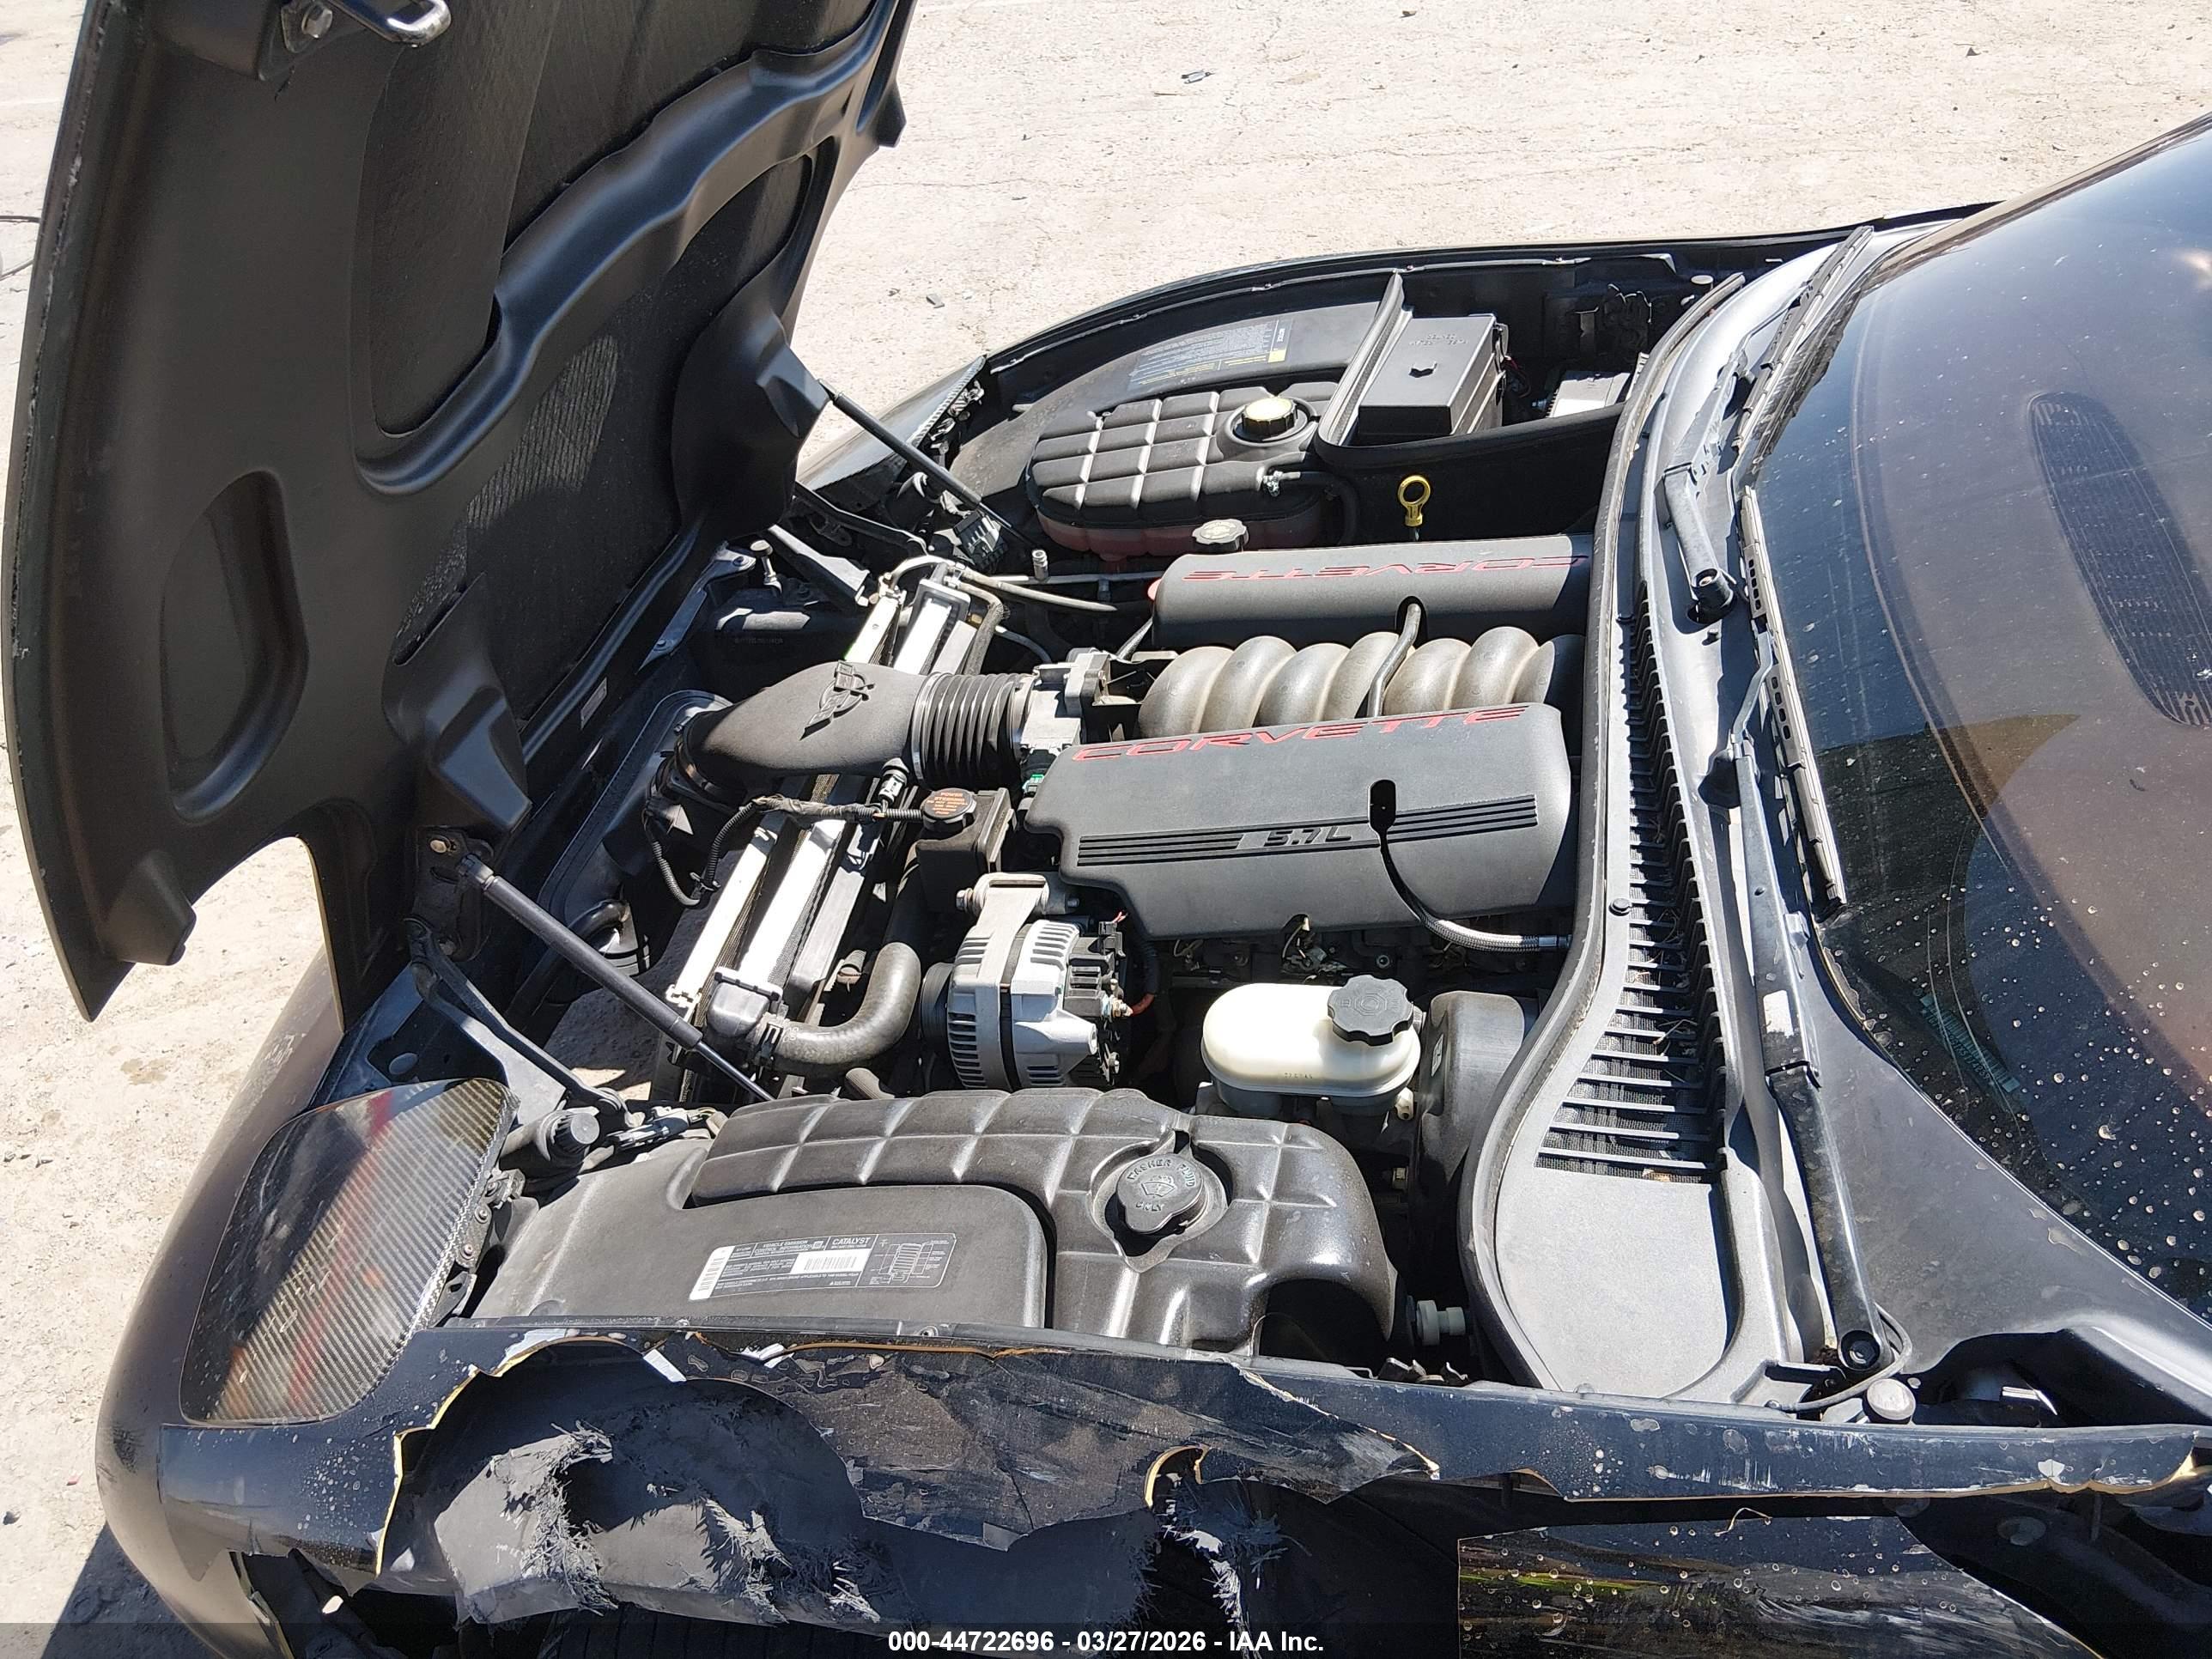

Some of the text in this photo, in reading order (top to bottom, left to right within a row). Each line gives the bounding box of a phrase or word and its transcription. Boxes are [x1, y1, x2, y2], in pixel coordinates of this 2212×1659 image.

[1182, 556, 1589, 581] CORVETTE
[1072, 705, 1530, 763] CORVETTE
[1267, 825, 1352, 848] 5.7L
[1135, 1201, 1165, 1212] ONLY
